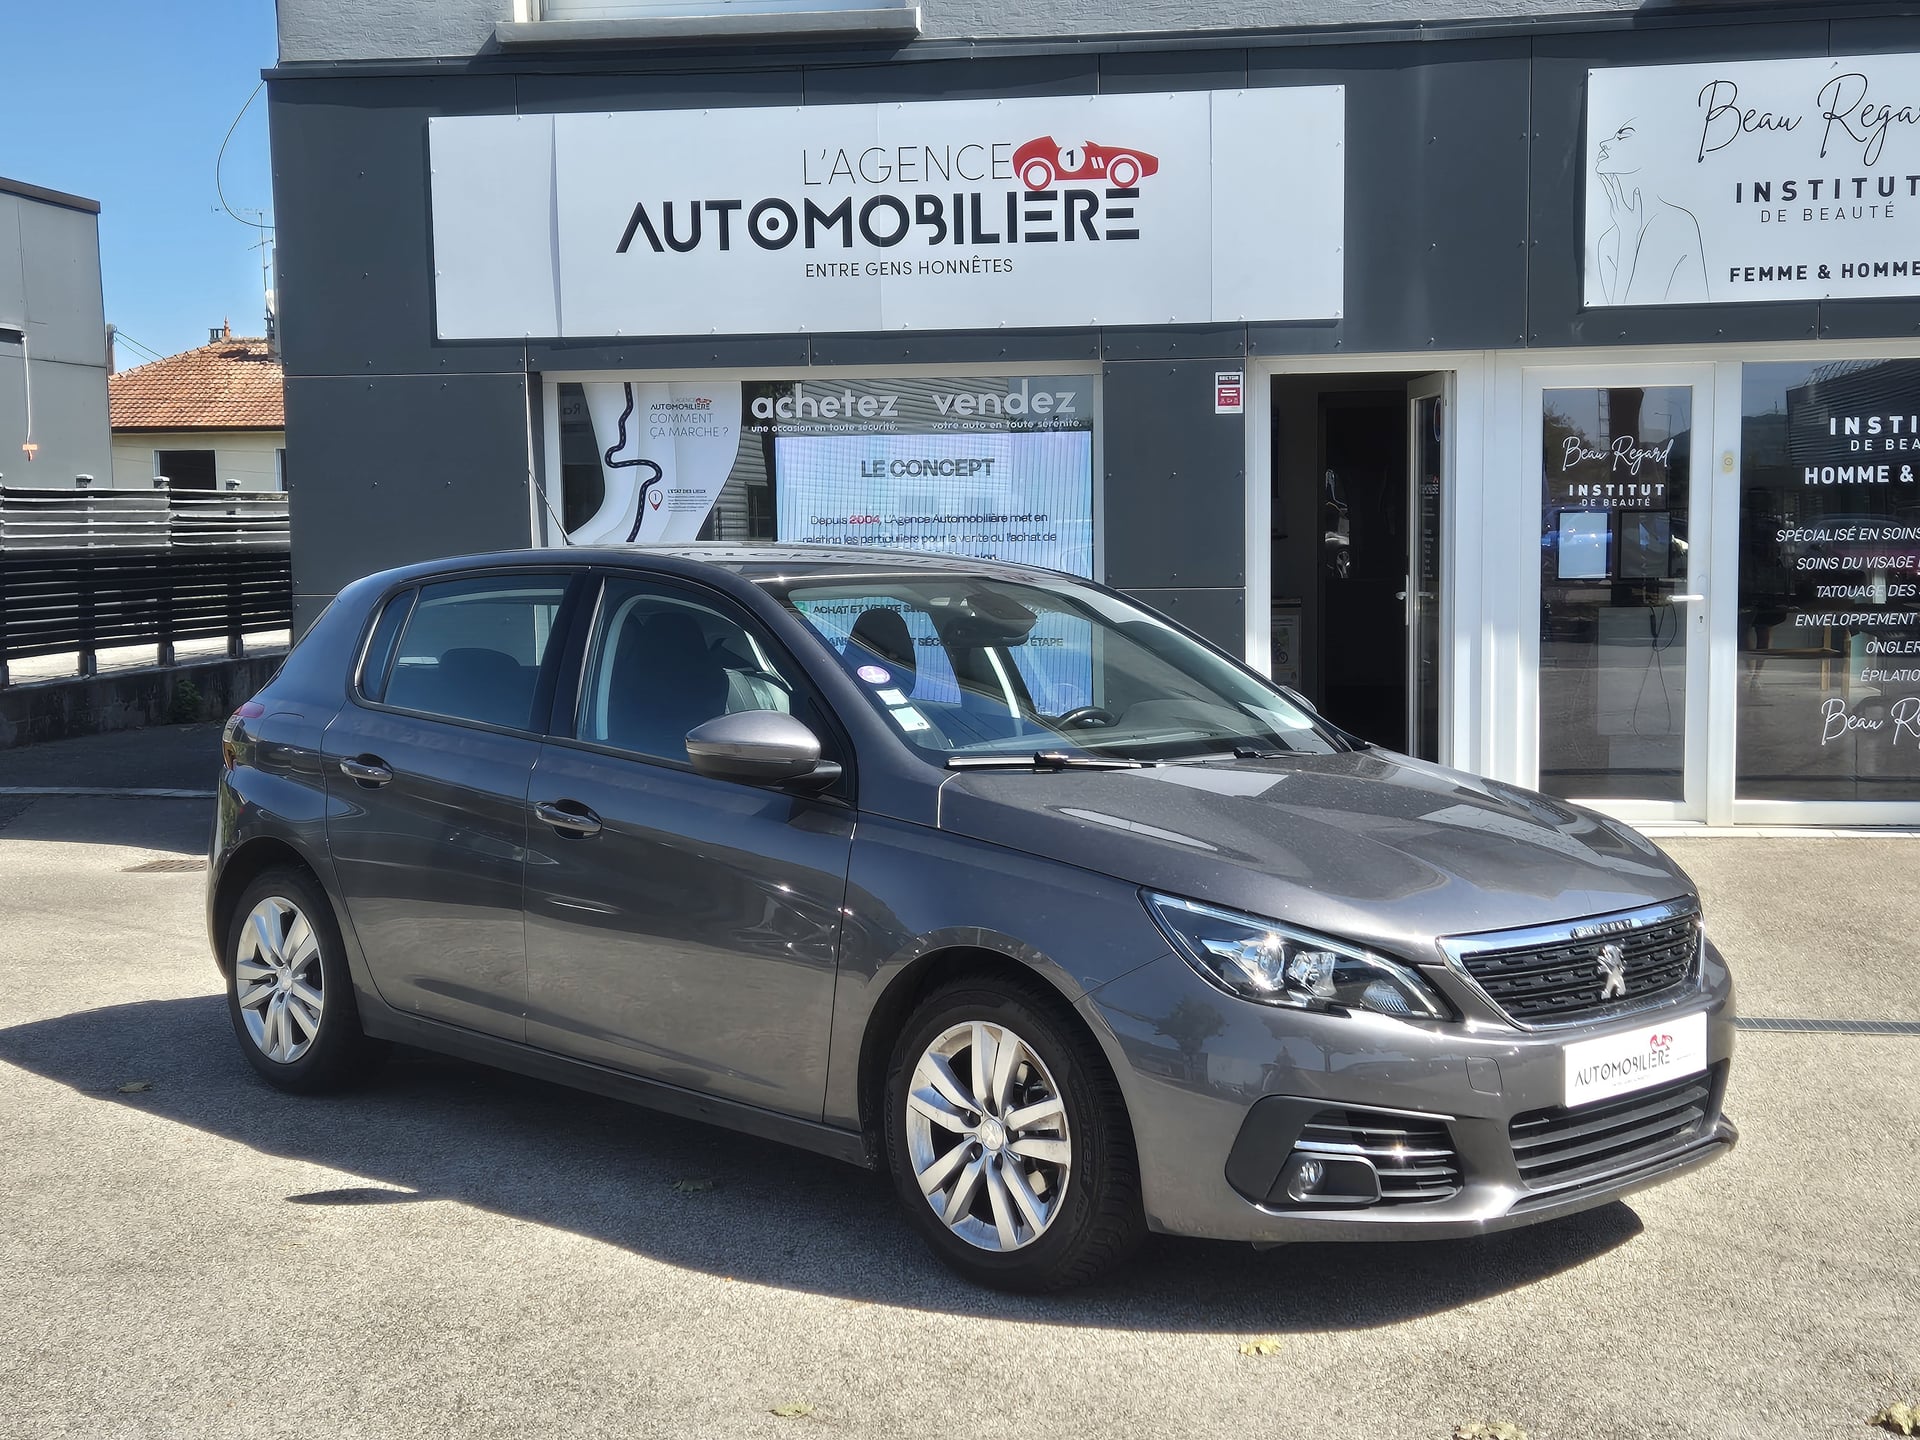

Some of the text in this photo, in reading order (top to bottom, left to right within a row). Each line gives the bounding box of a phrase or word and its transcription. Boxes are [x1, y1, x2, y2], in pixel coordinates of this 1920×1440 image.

[1697, 73, 1920, 166] Beau Rega
[803, 143, 1012, 185] L'AGENCE
[1735, 175, 1920, 203] INSTITUT
[1760, 201, 1895, 223] DE BEAUTÉ
[805, 254, 1013, 278] ENTRE GENS HONNÊTES
[1729, 260, 1920, 283] FEMME & HOMME
[751, 382, 899, 419] achetez
[932, 379, 1077, 416] vendez
[650, 413, 714, 424] COMMENT
[932, 420, 959, 430] votre
[962, 421, 986, 429] auto
[1007, 419, 1034, 429] toute
[1037, 417, 1082, 428] sérénité.
[1830, 415, 1917, 435] INSTI
[650, 426, 729, 440] ÇA MARCHE ?
[751, 425, 768, 433] une
[772, 423, 812, 432] occasion
[829, 423, 854, 431] toute
[859, 421, 898, 432] sécurité.
[1850, 438, 1920, 451] DE BEA
[1562, 435, 1674, 476] Beau Regard
[861, 457, 995, 478] LE CONCEPT
[1804, 465, 1914, 485] HOMME &
[1568, 484, 1666, 496] INSTITUT
[1581, 497, 1651, 507] DE BEAUTÉ
[810, 515, 847, 526] Depuis
[884, 514, 931, 526] L'Agence
[1010, 513, 1032, 522] met
[1034, 513, 1048, 522] en
[921, 534, 947, 545] pour
[959, 533, 989, 542] vente
[1042, 532, 1057, 542] de
[1775, 526, 1857, 542] SPÉCIALISÉ
[1858, 528, 1880, 540] EN
[1796, 557, 1839, 570] SOINS
[1841, 557, 1863, 569] DU
[1866, 556, 1916, 568] VISAGE
[1816, 584, 1916, 598] TATOUAGE DES
[813, 605, 848, 614] ACHAT
[850, 605, 863, 614] ET
[1795, 613, 1917, 627] ENVELOPPEMENT
[1030, 635, 1064, 646] ÉTAPE
[1860, 668, 1920, 682] ÉPILATIO
[1821, 698, 1883, 746] Beau
